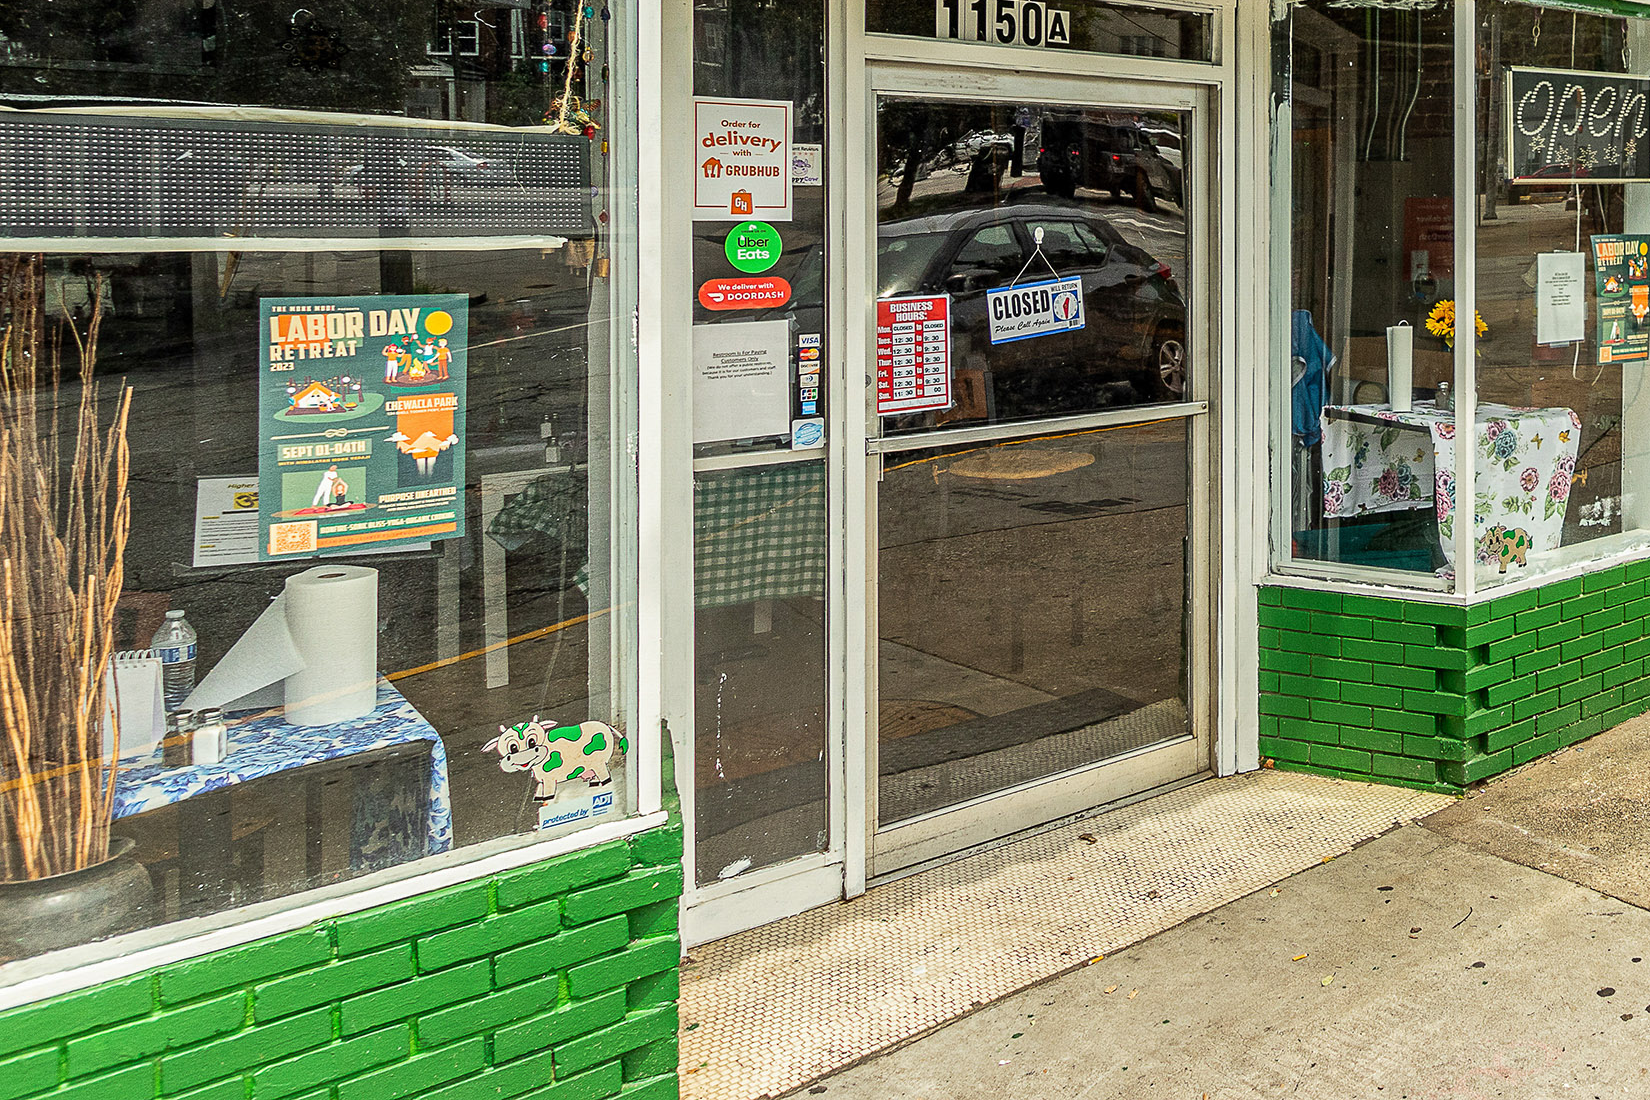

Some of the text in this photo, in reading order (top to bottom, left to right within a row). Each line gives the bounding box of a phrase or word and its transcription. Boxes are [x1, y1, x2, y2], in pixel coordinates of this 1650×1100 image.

[721, 119, 761, 129] Order for
[1516, 81, 1648, 164] open
[702, 130, 782, 153] delivery
[732, 149, 752, 157] with
[725, 164, 780, 177] GRUBHUB
[734, 196, 748, 212] GH
[737, 235, 769, 248] Uber
[737, 249, 770, 260] Eats
[1595, 240, 1640, 257] LABOR DAY
[1596, 256, 1624, 267] RETREAT
[727, 291, 785, 301] DOORDASH
[889, 301, 933, 313] BUSINESS
[992, 289, 1051, 321] CLOSED
[895, 311, 928, 322] HOURS:
[269, 307, 421, 343] LABOR DAY
[994, 318, 1051, 334] Please Call Again
[801, 336, 820, 344] VISA
[269, 340, 358, 362] RETREAT
[270, 362, 295, 372] 2023
[385, 398, 433, 411] CHEWACLA
[433, 395, 459, 408] PARK
[282, 440, 366, 459] SEPT 01-04TH
[378, 491, 415, 504] PURPOSE
[542, 809, 580, 827] protected
[580, 808, 589, 817] by
[593, 795, 612, 806] ADT
